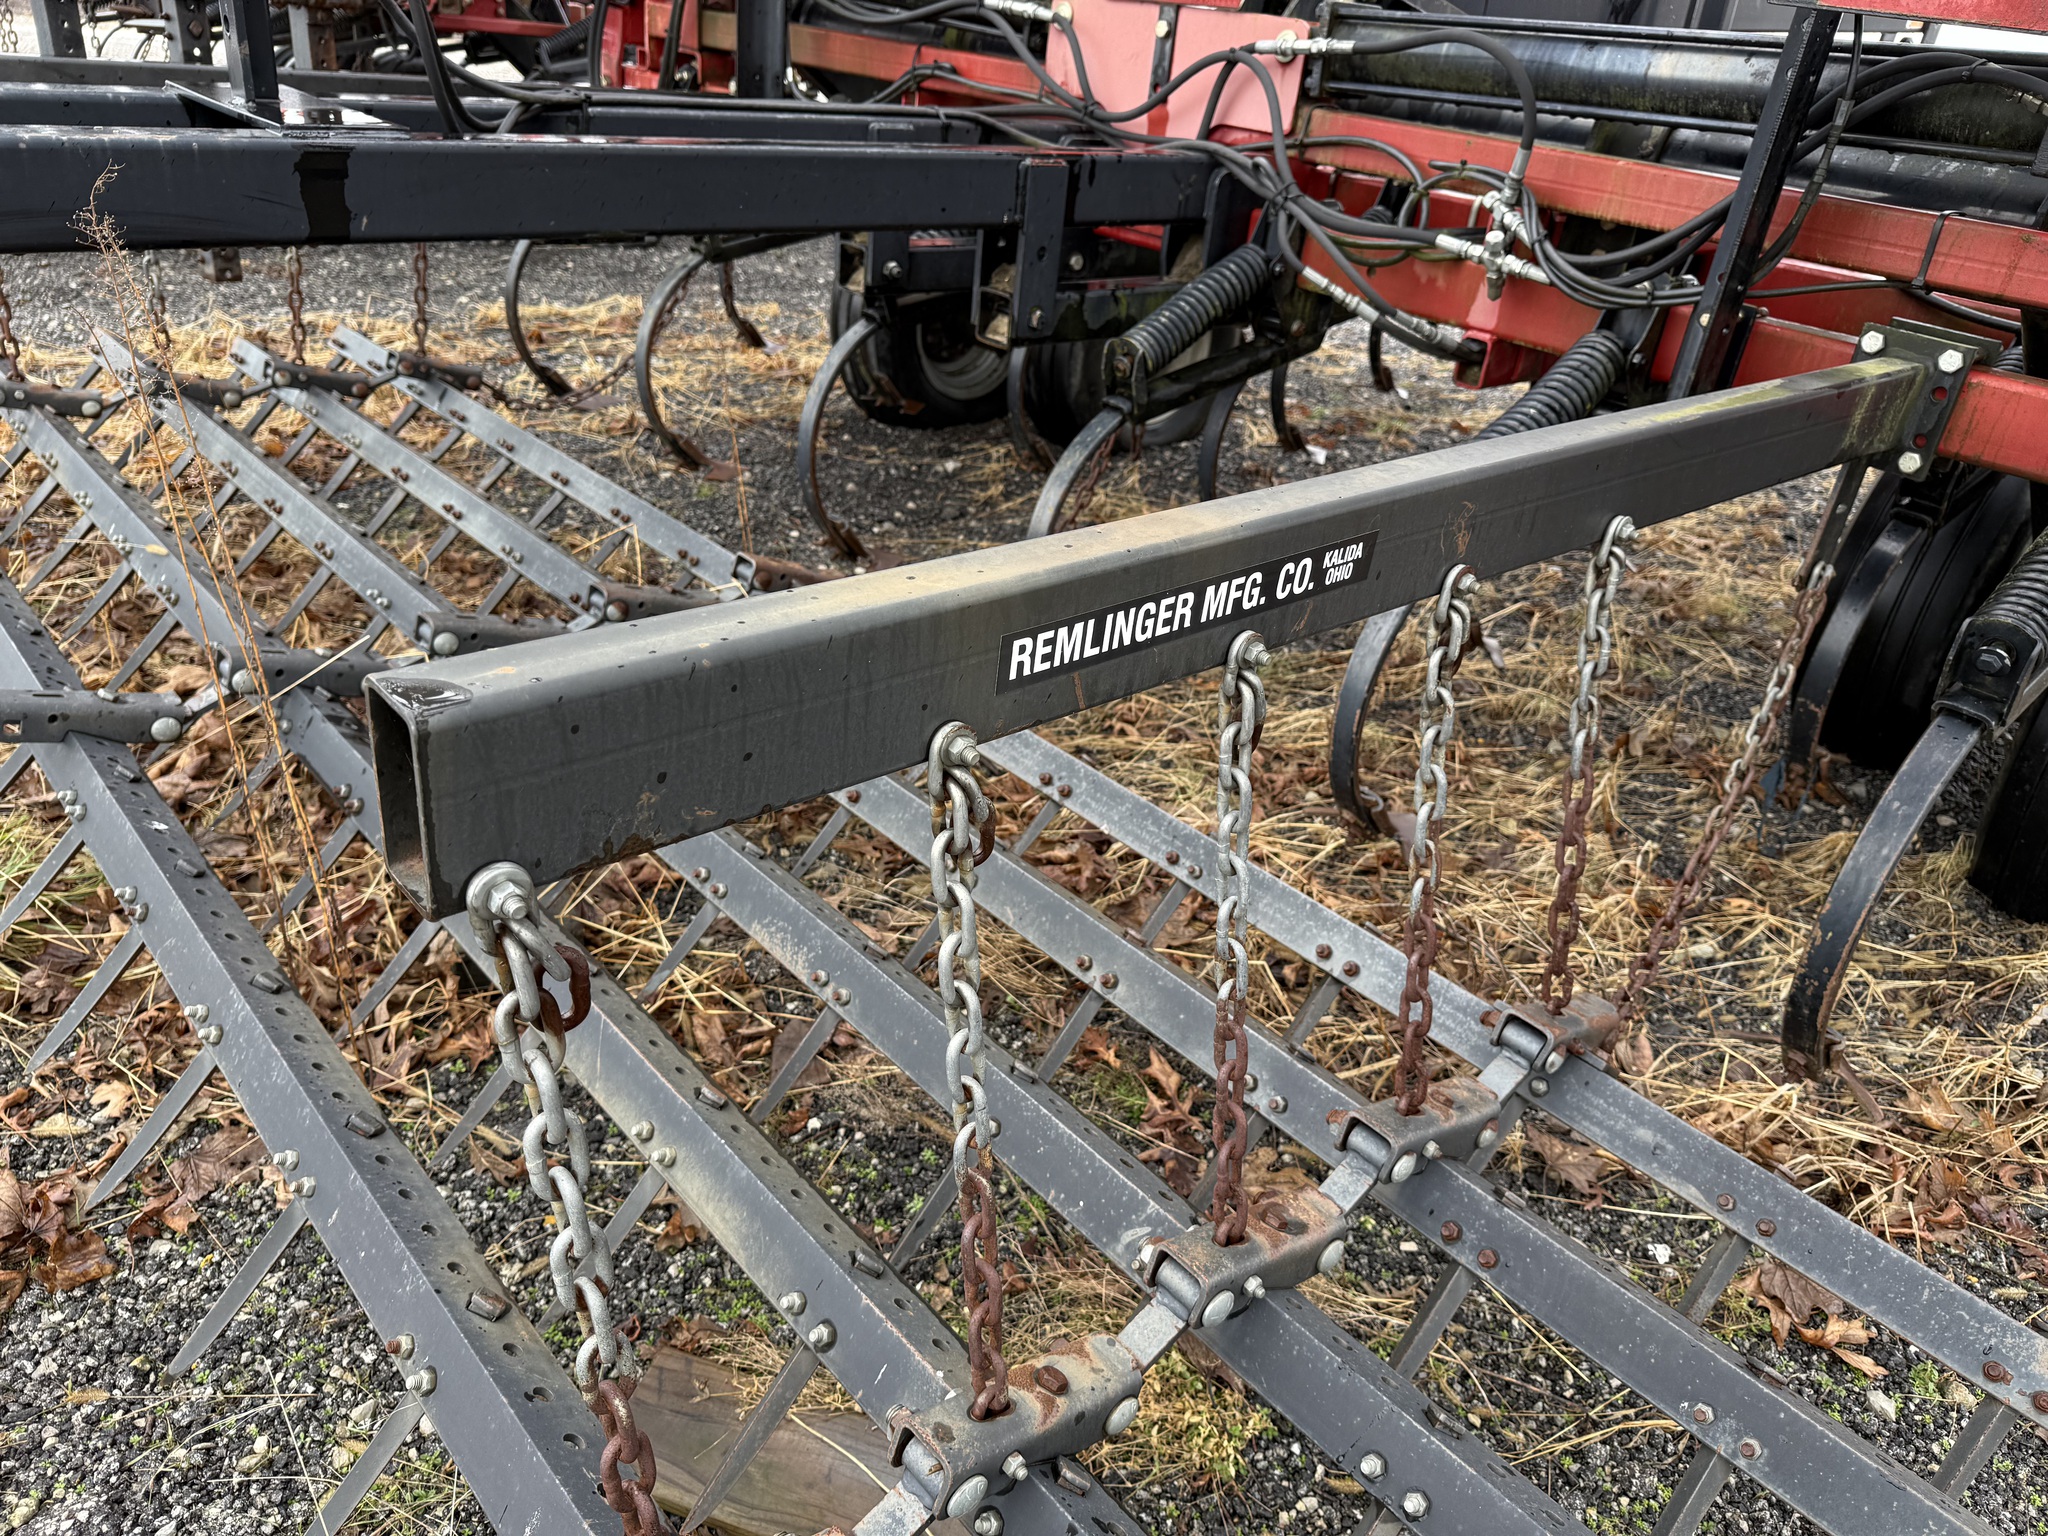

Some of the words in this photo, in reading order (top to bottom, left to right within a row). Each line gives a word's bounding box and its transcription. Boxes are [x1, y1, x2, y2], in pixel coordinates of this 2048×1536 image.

[1322, 541, 1364, 570] KALIDA
[1324, 561, 1354, 586] OHIO
[1008, 592, 1195, 681] REMLINGER
[1200, 572, 1266, 623] MFG.
[1275, 557, 1315, 600] CO.
